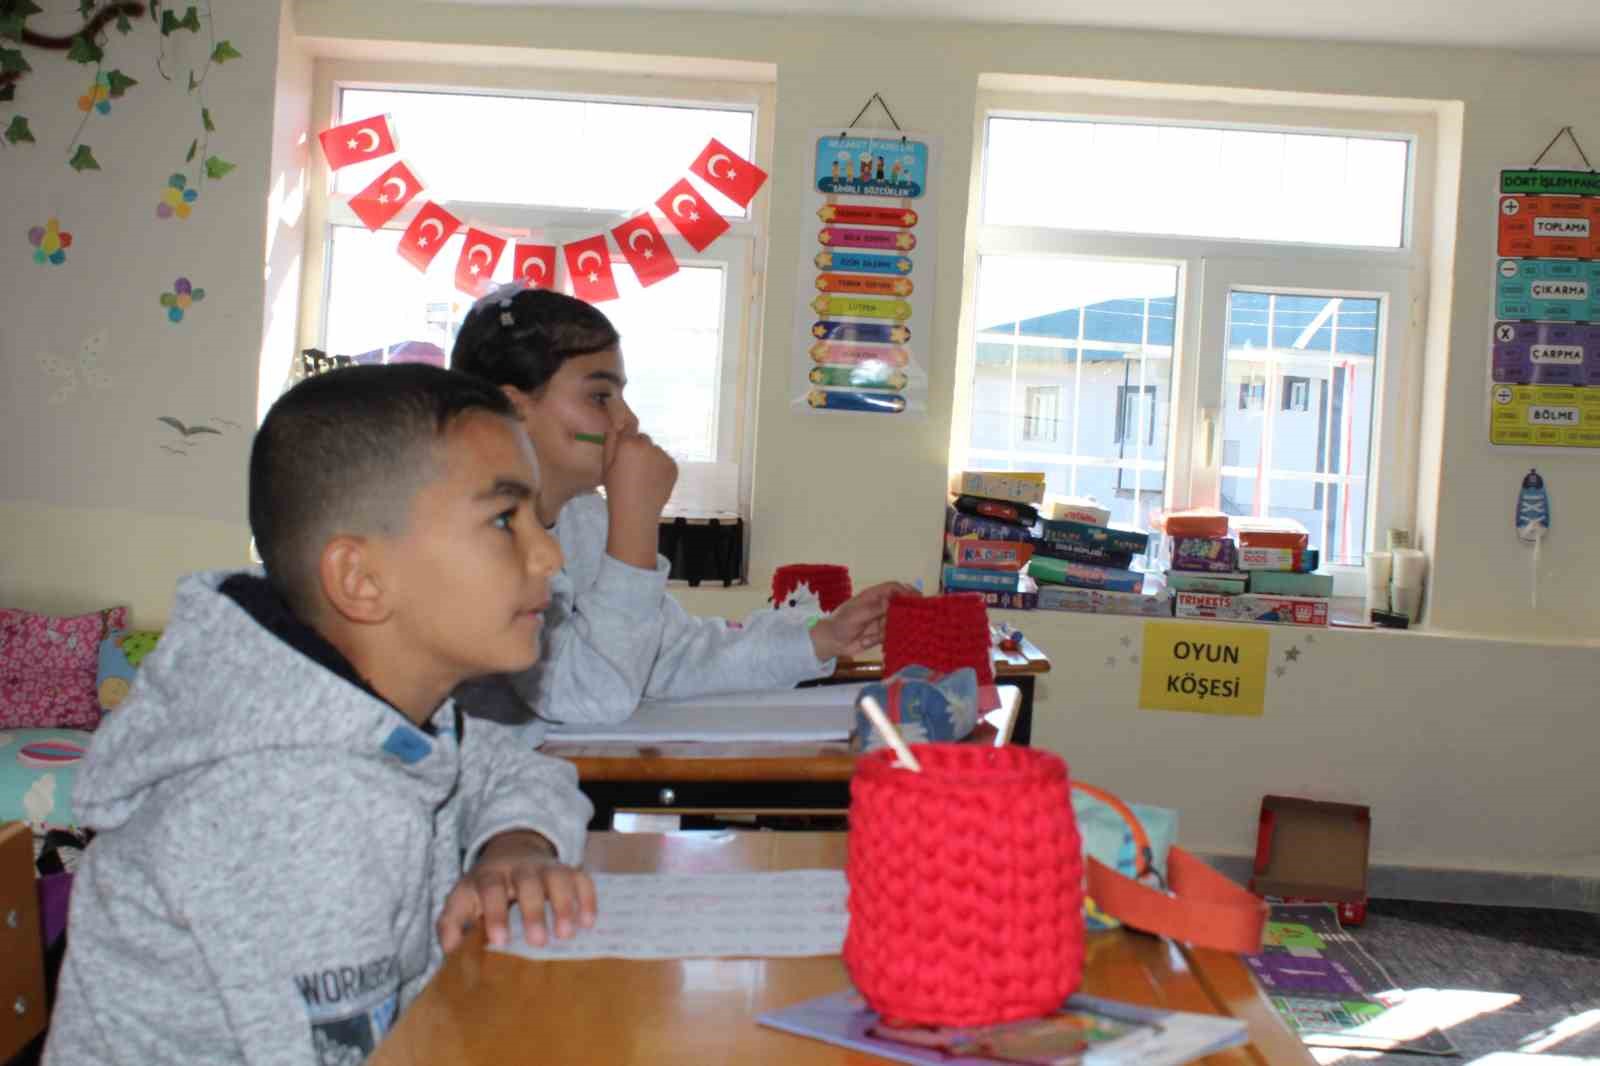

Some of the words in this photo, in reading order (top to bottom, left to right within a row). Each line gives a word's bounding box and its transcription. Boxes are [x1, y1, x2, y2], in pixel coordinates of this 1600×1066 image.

[1537, 221, 1588, 232] TOPLAMA
[1533, 284, 1585, 296] ÇIKARMA
[1532, 349, 1580, 360] ÇARPMA
[1534, 409, 1574, 421] BÖLME
[1173, 641, 1240, 664] OYUN
[1167, 672, 1241, 699] KÖŞESİ
